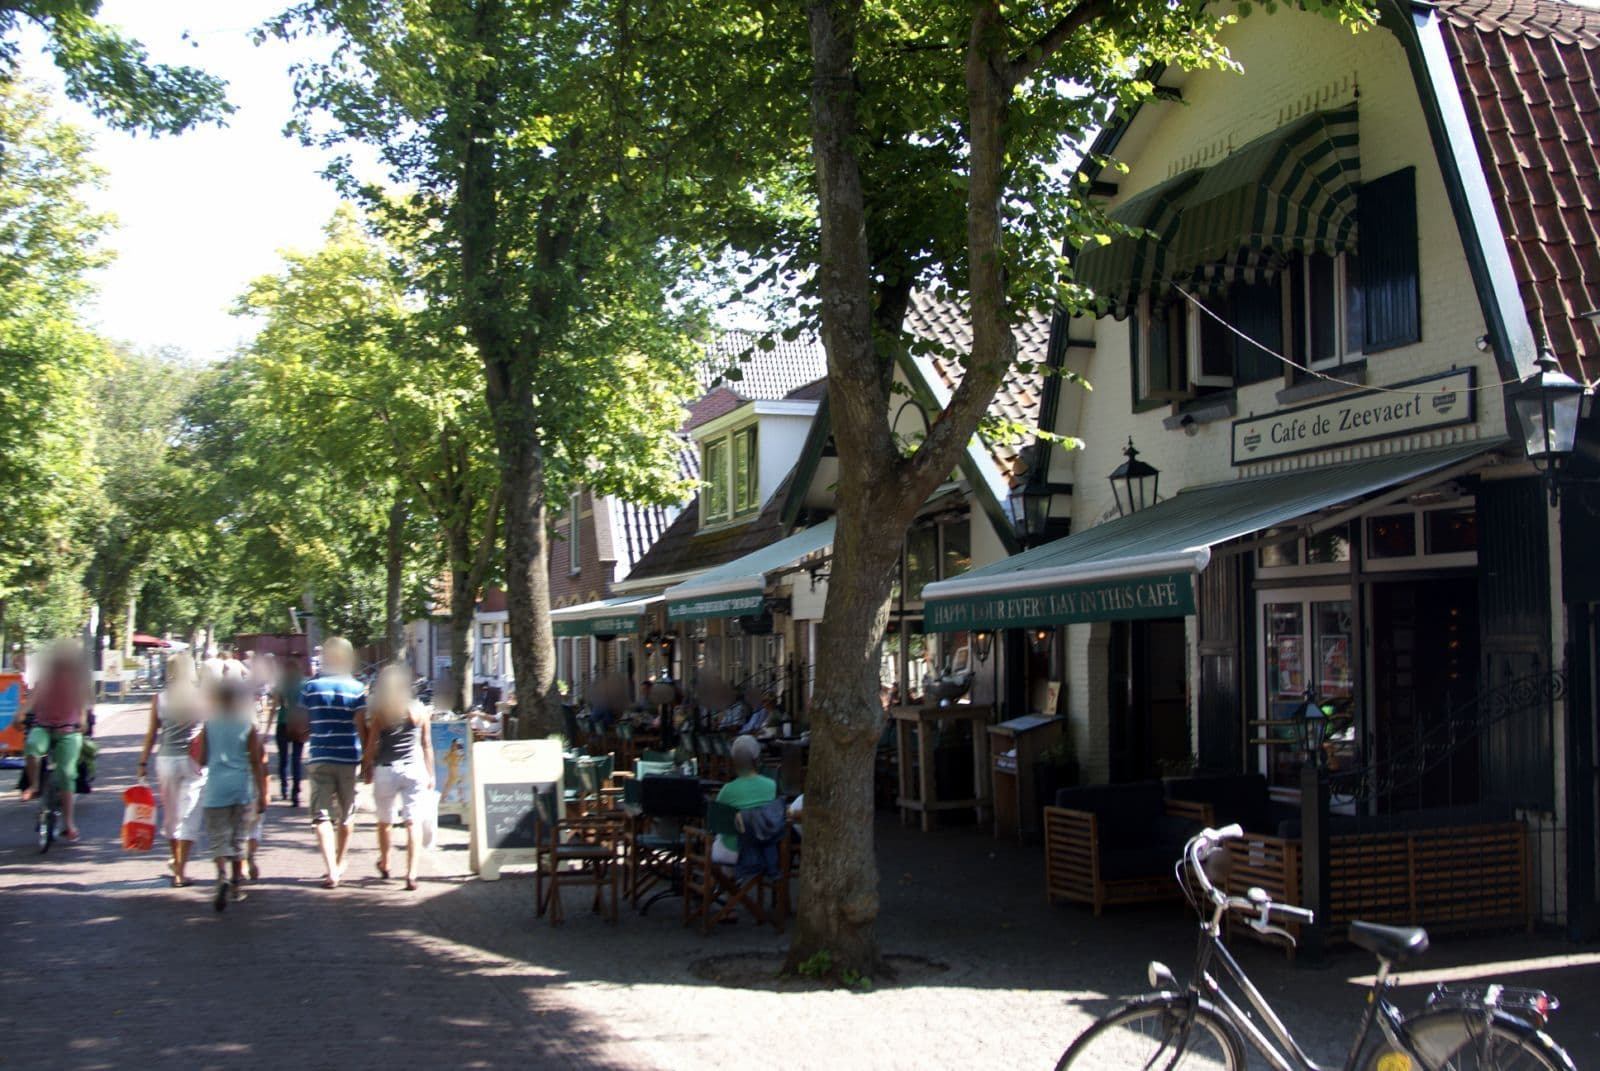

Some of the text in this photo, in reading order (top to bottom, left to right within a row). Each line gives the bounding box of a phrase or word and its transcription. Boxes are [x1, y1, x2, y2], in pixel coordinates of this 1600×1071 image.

[1312, 414, 1330, 436] de
[1338, 392, 1421, 432] Zeevaert
[934, 602, 968, 624] HAPPY
[1007, 595, 1048, 619] EVERY
[1049, 591, 1076, 615] DAY
[1080, 591, 1097, 613] IN
[1097, 587, 1135, 611] THIS
[1137, 576, 1179, 607] CAFÉ
